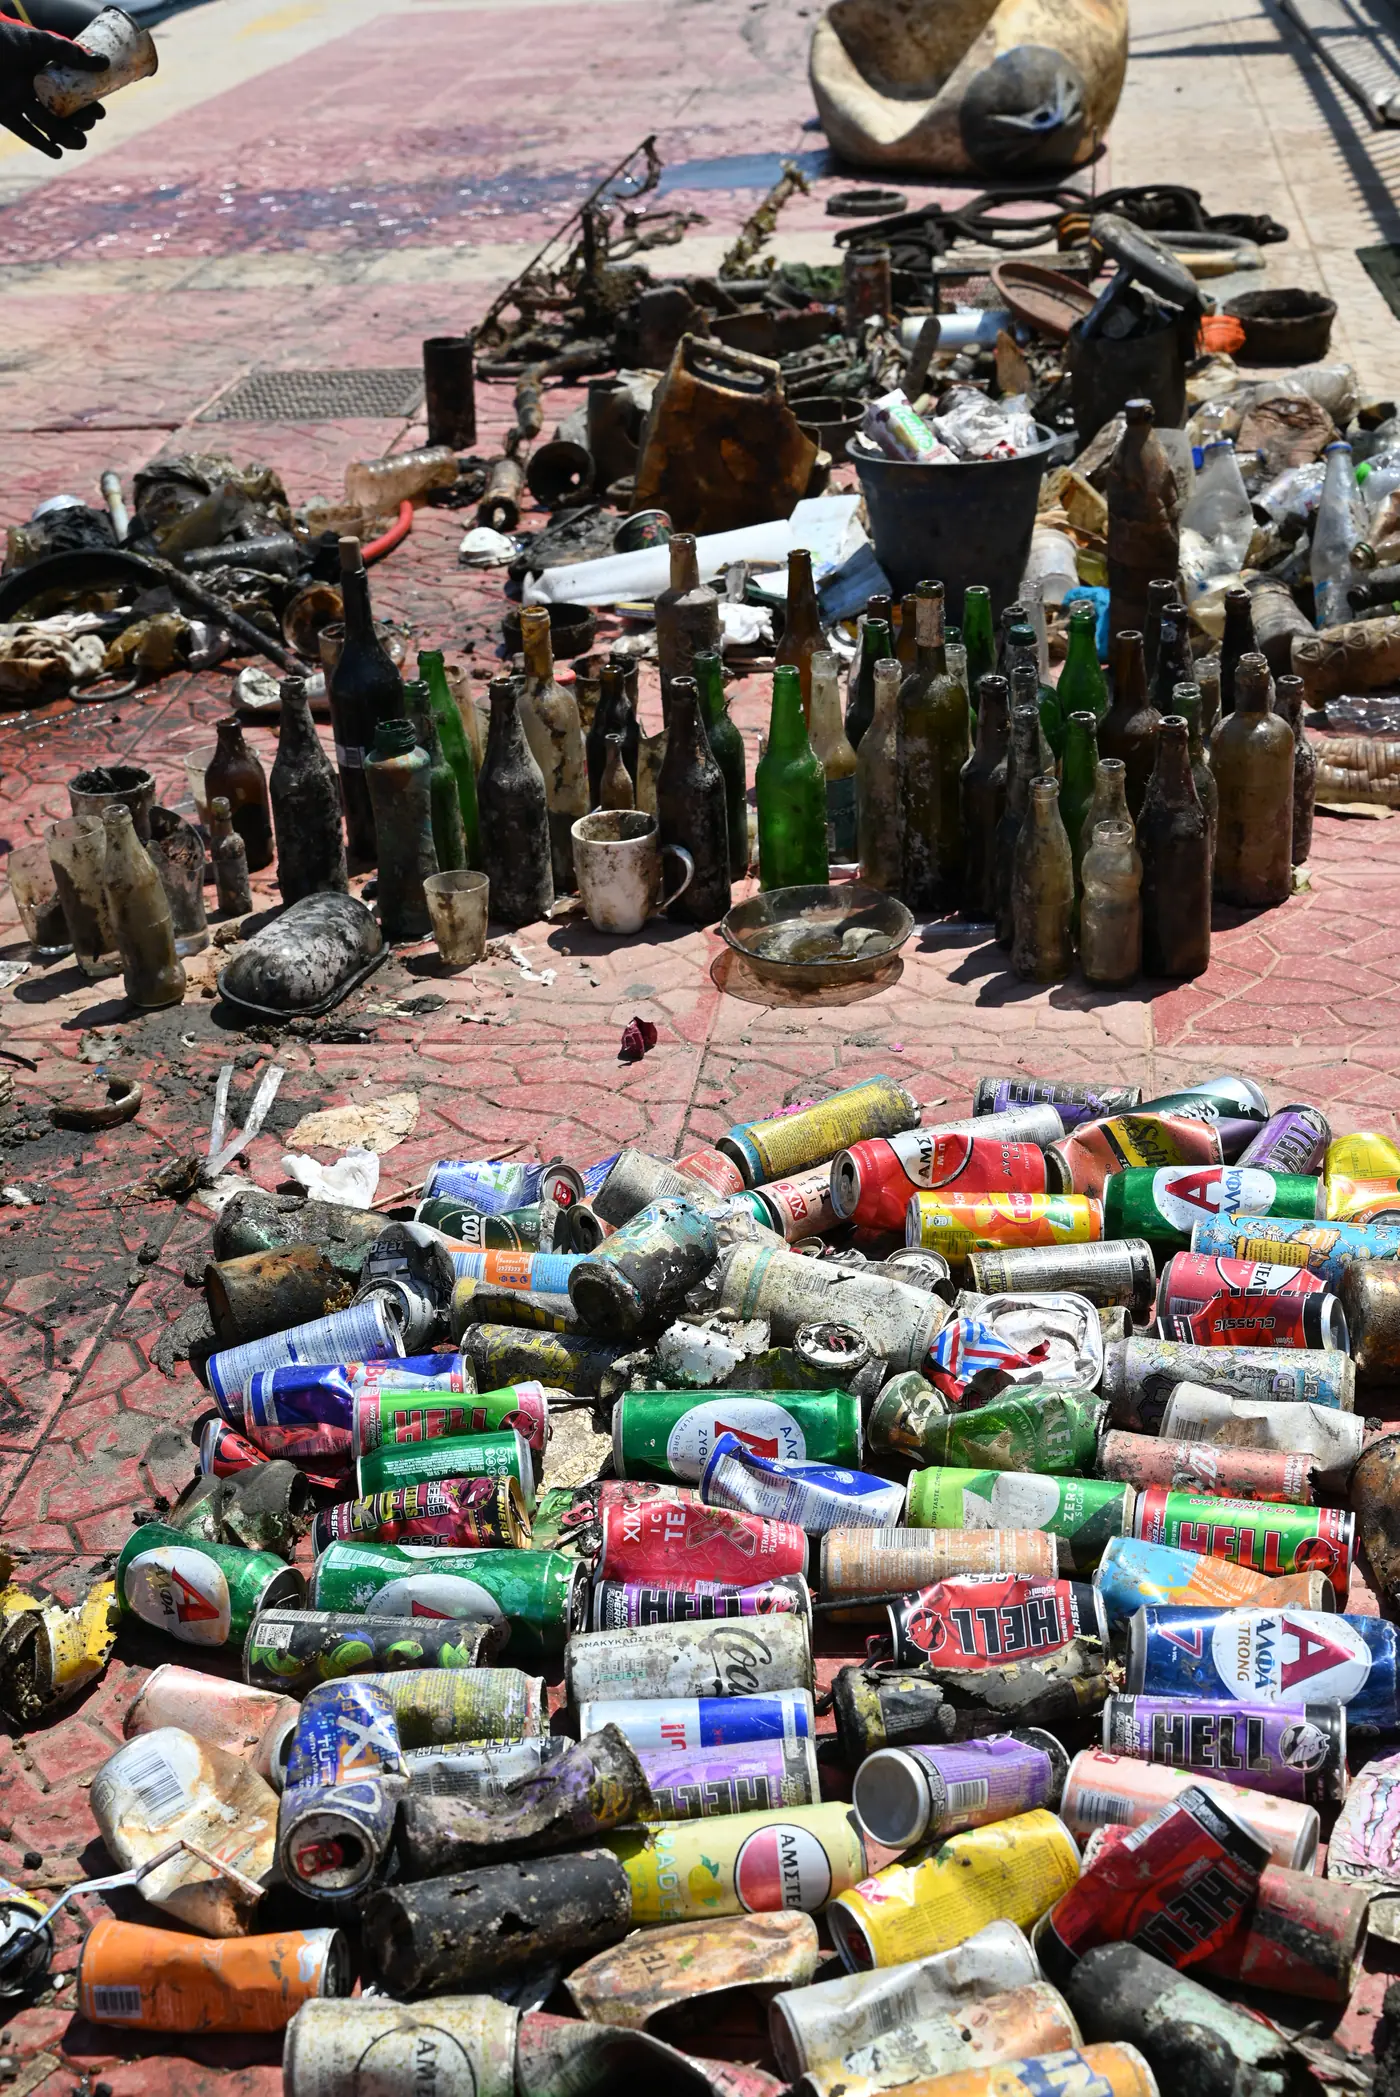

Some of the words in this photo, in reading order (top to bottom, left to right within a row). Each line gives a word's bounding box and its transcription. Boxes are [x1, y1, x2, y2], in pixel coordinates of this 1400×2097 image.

[1268, 1124, 1322, 1175] HELL
[1213, 1316, 1277, 1333] CLASSIC
[393, 1407, 488, 1445] HELL
[428, 1505, 450, 1517] SARY
[650, 1500, 662, 1533] ICE
[1063, 1482, 1079, 1522] ZERO
[1189, 1497, 1297, 1516] WATERMELON
[1177, 1520, 1287, 1577] HELL
[638, 1588, 742, 1627] HELL
[950, 1598, 1062, 1656] HELL
[1236, 1618, 1251, 1683] STRONG
[1254, 1617, 1277, 1690] ΑΛΦΑ
[317, 1734, 334, 1787] TUTT
[1151, 1713, 1272, 1771] HELL
